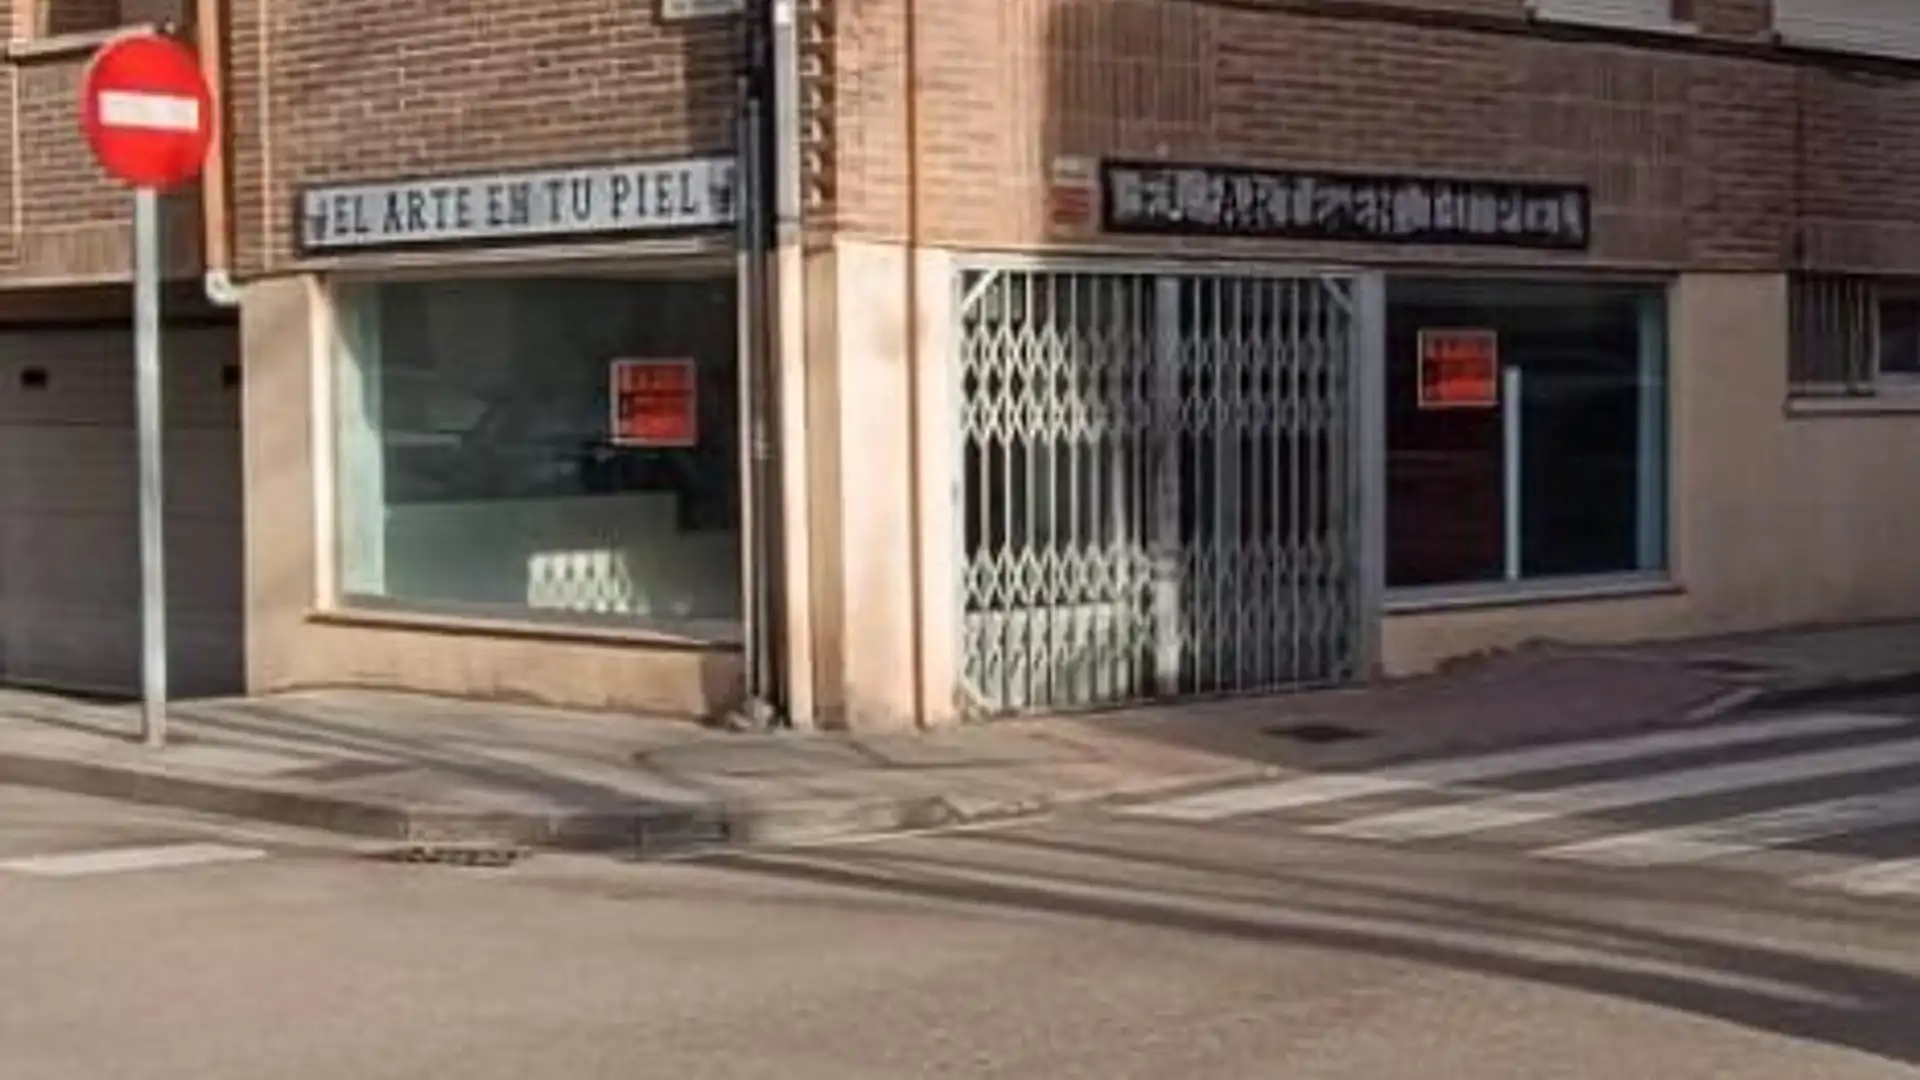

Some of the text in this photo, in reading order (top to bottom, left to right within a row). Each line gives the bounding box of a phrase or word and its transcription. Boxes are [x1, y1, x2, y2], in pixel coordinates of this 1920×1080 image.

[334, 194, 371, 235] EL
[383, 186, 472, 233] ARTE
[543, 177, 591, 222] TU
[610, 171, 696, 218] PIEL
